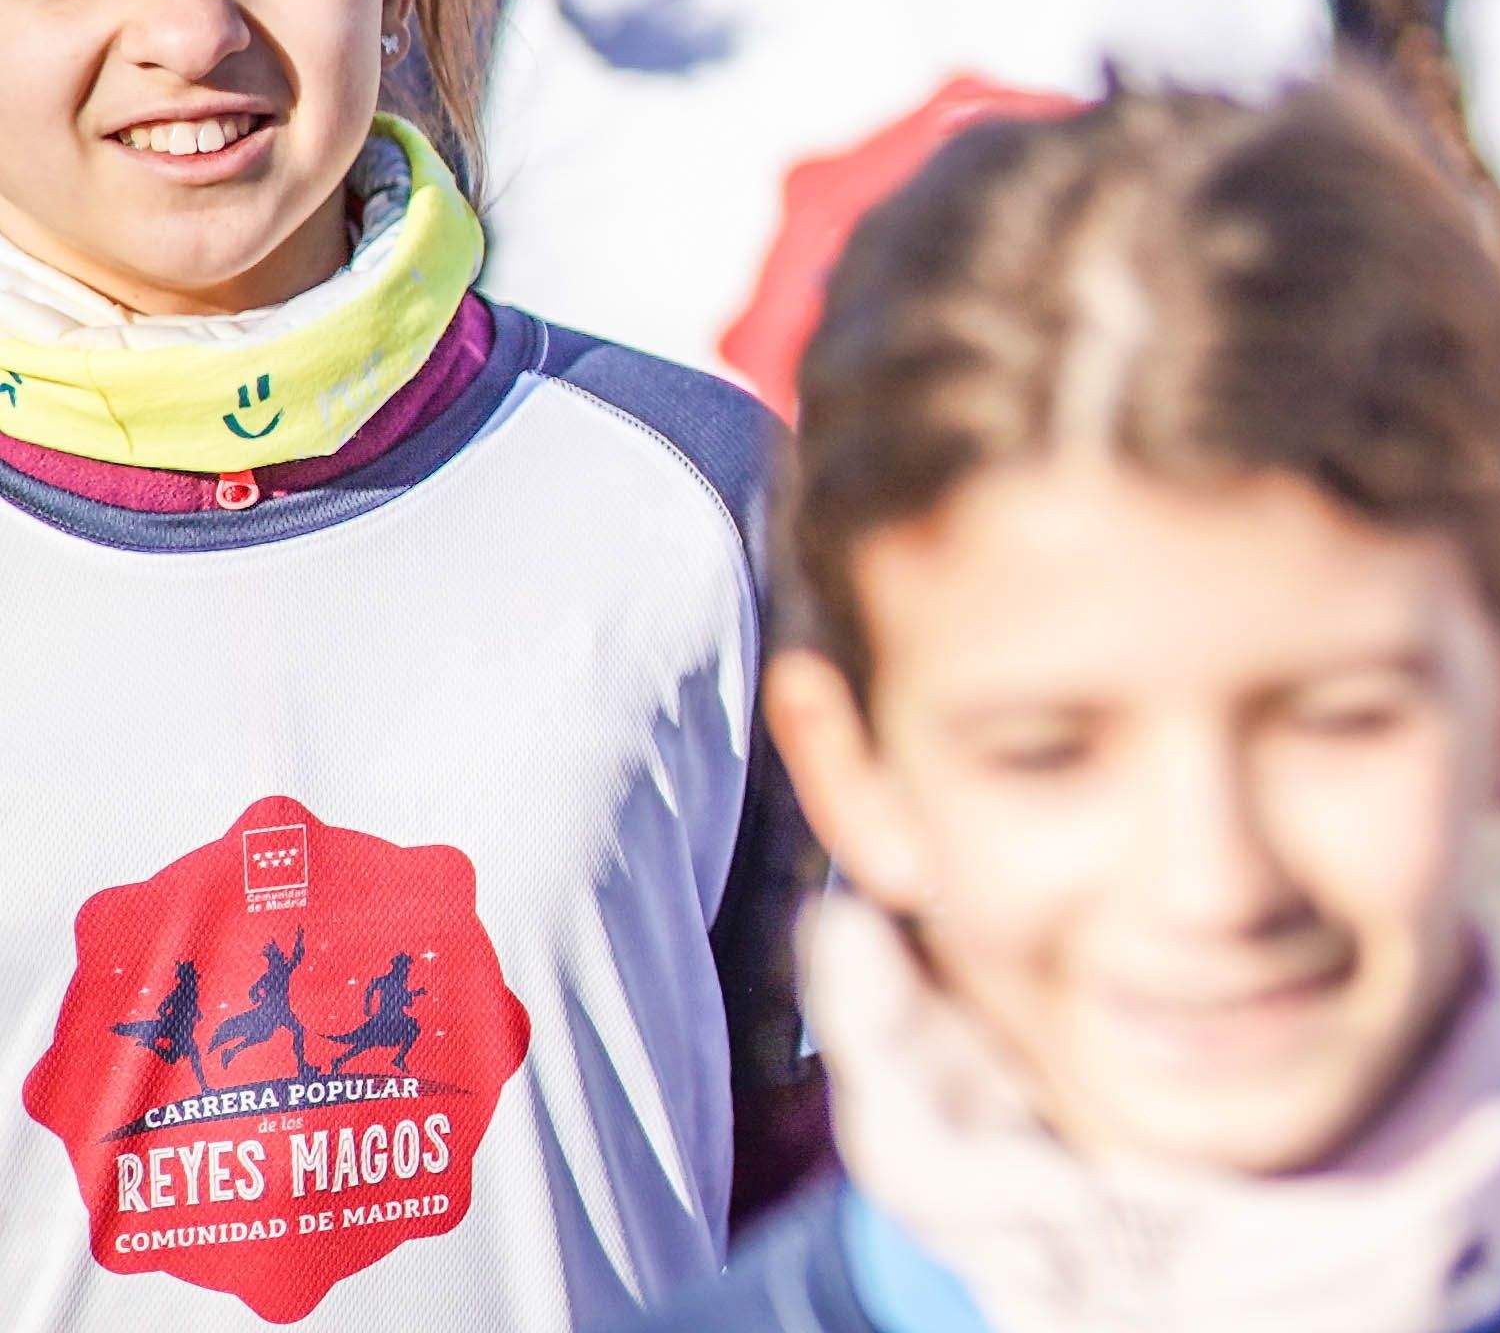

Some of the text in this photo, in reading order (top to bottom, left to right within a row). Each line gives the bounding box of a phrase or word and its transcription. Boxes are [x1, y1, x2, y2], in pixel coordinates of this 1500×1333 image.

[145, 1078, 420, 1128] CARRERA POPULAR
[258, 1116, 304, 1133] de los
[116, 1113, 451, 1213] REYES MAGOS
[115, 1194, 449, 1253] COMUNIDAD DE MADRID
